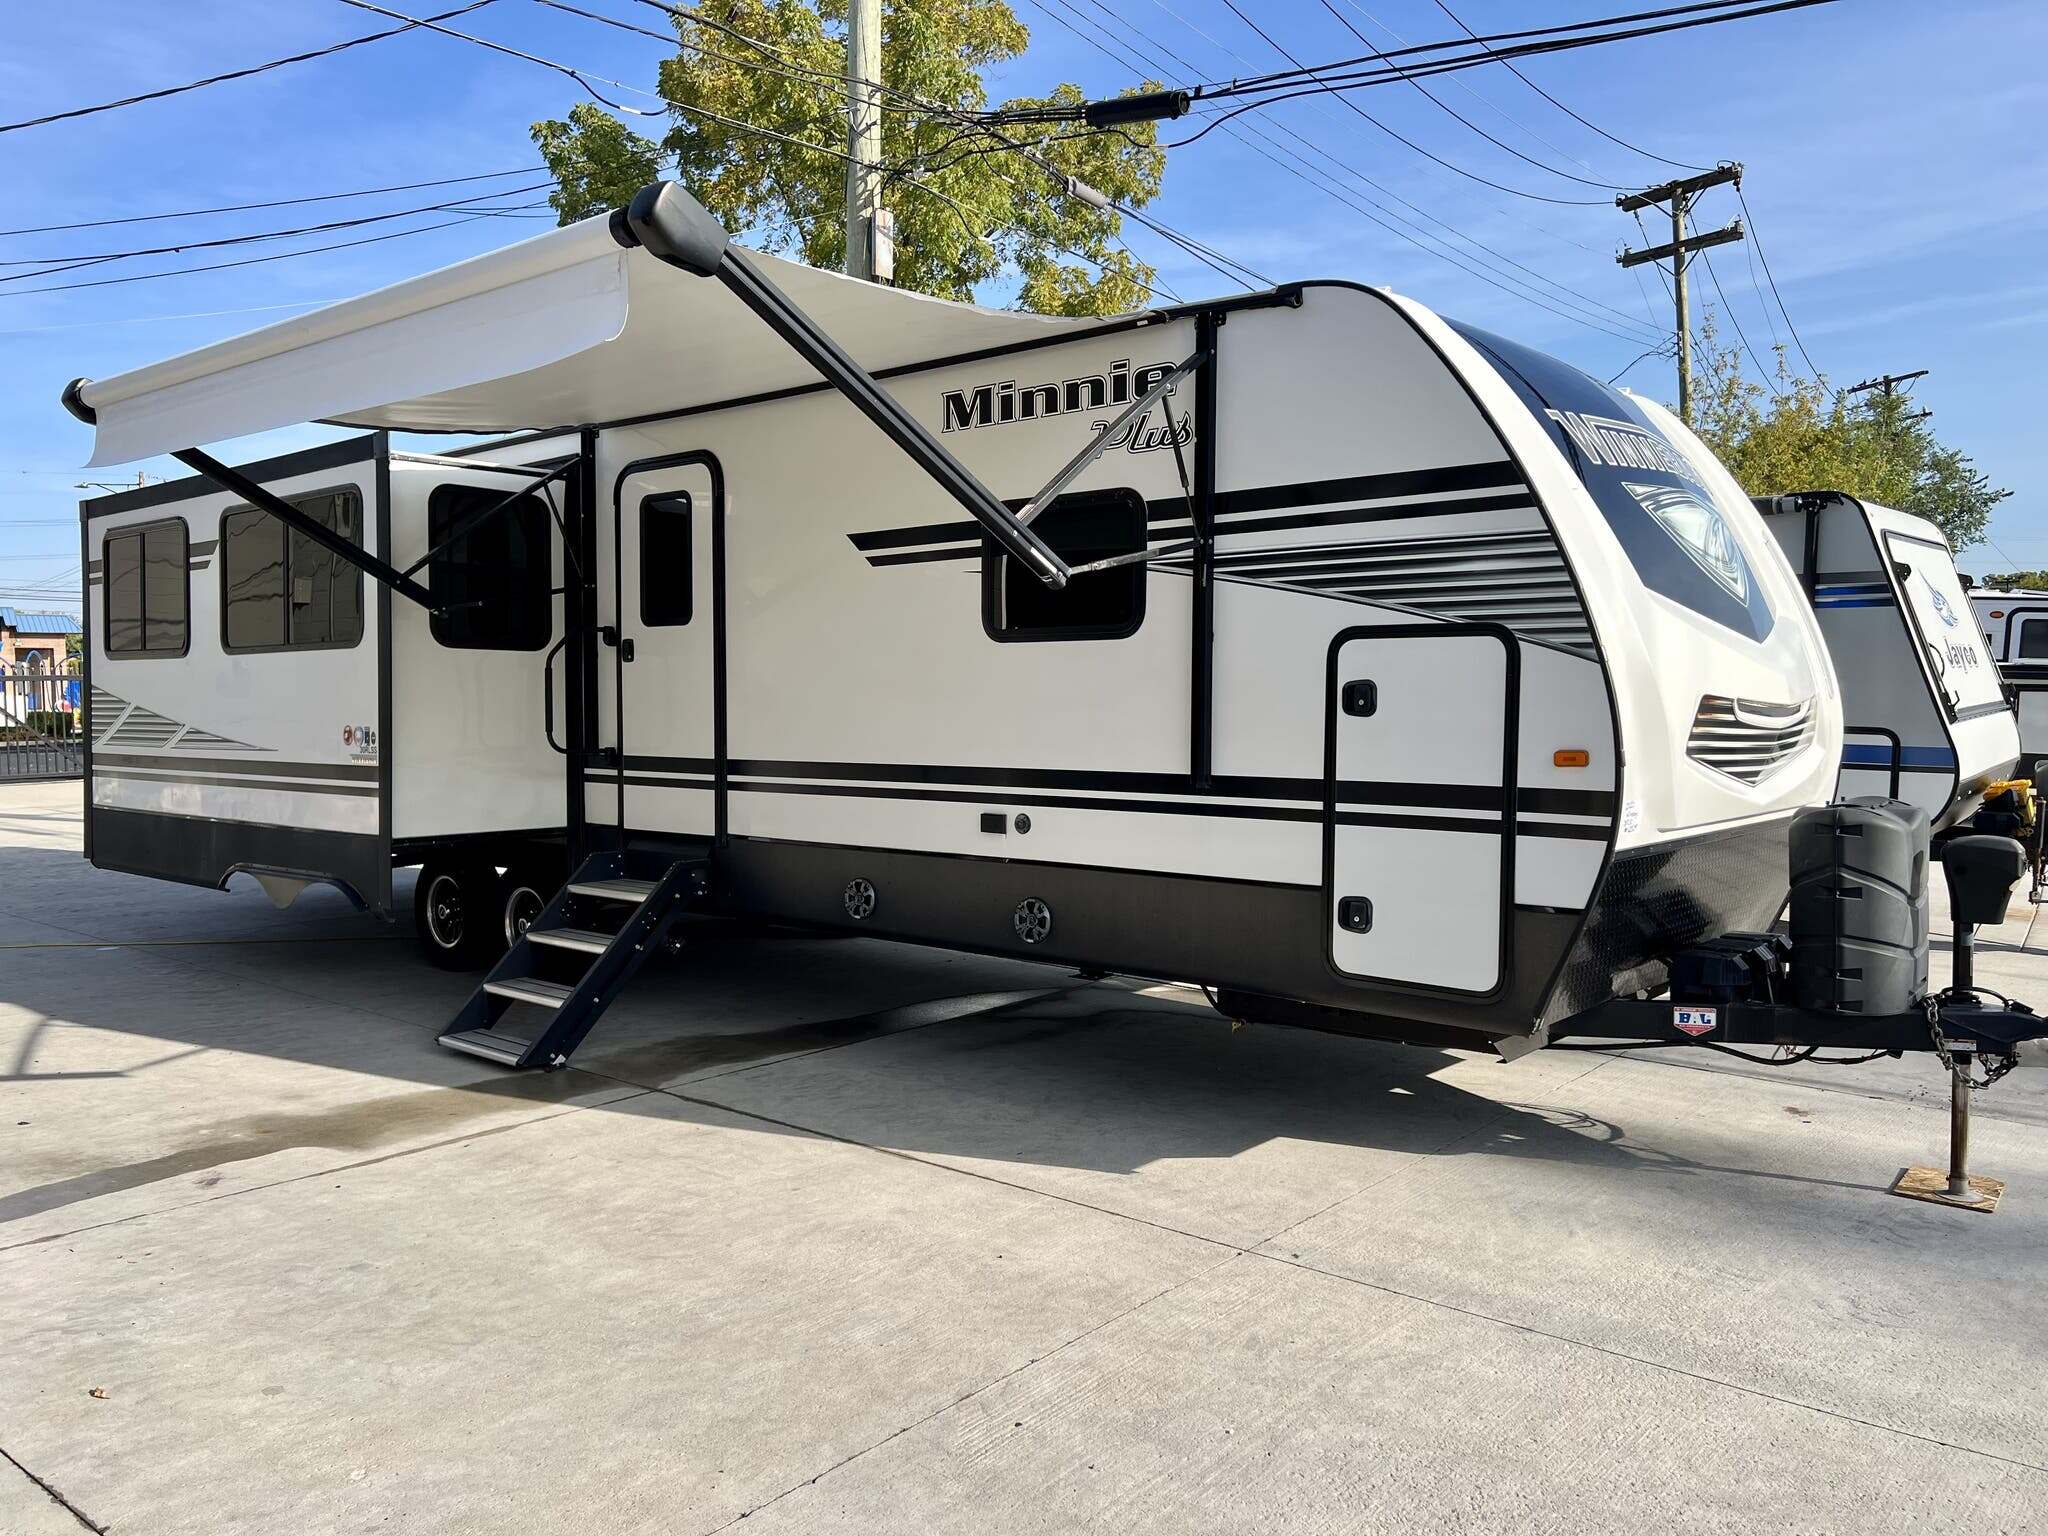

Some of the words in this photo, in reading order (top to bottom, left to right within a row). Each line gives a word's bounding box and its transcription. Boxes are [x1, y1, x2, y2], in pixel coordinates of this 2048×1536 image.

[941, 358, 1179, 433] Minnie
[1091, 411, 1196, 459] Plus
[1943, 635, 1978, 674] Jayco
